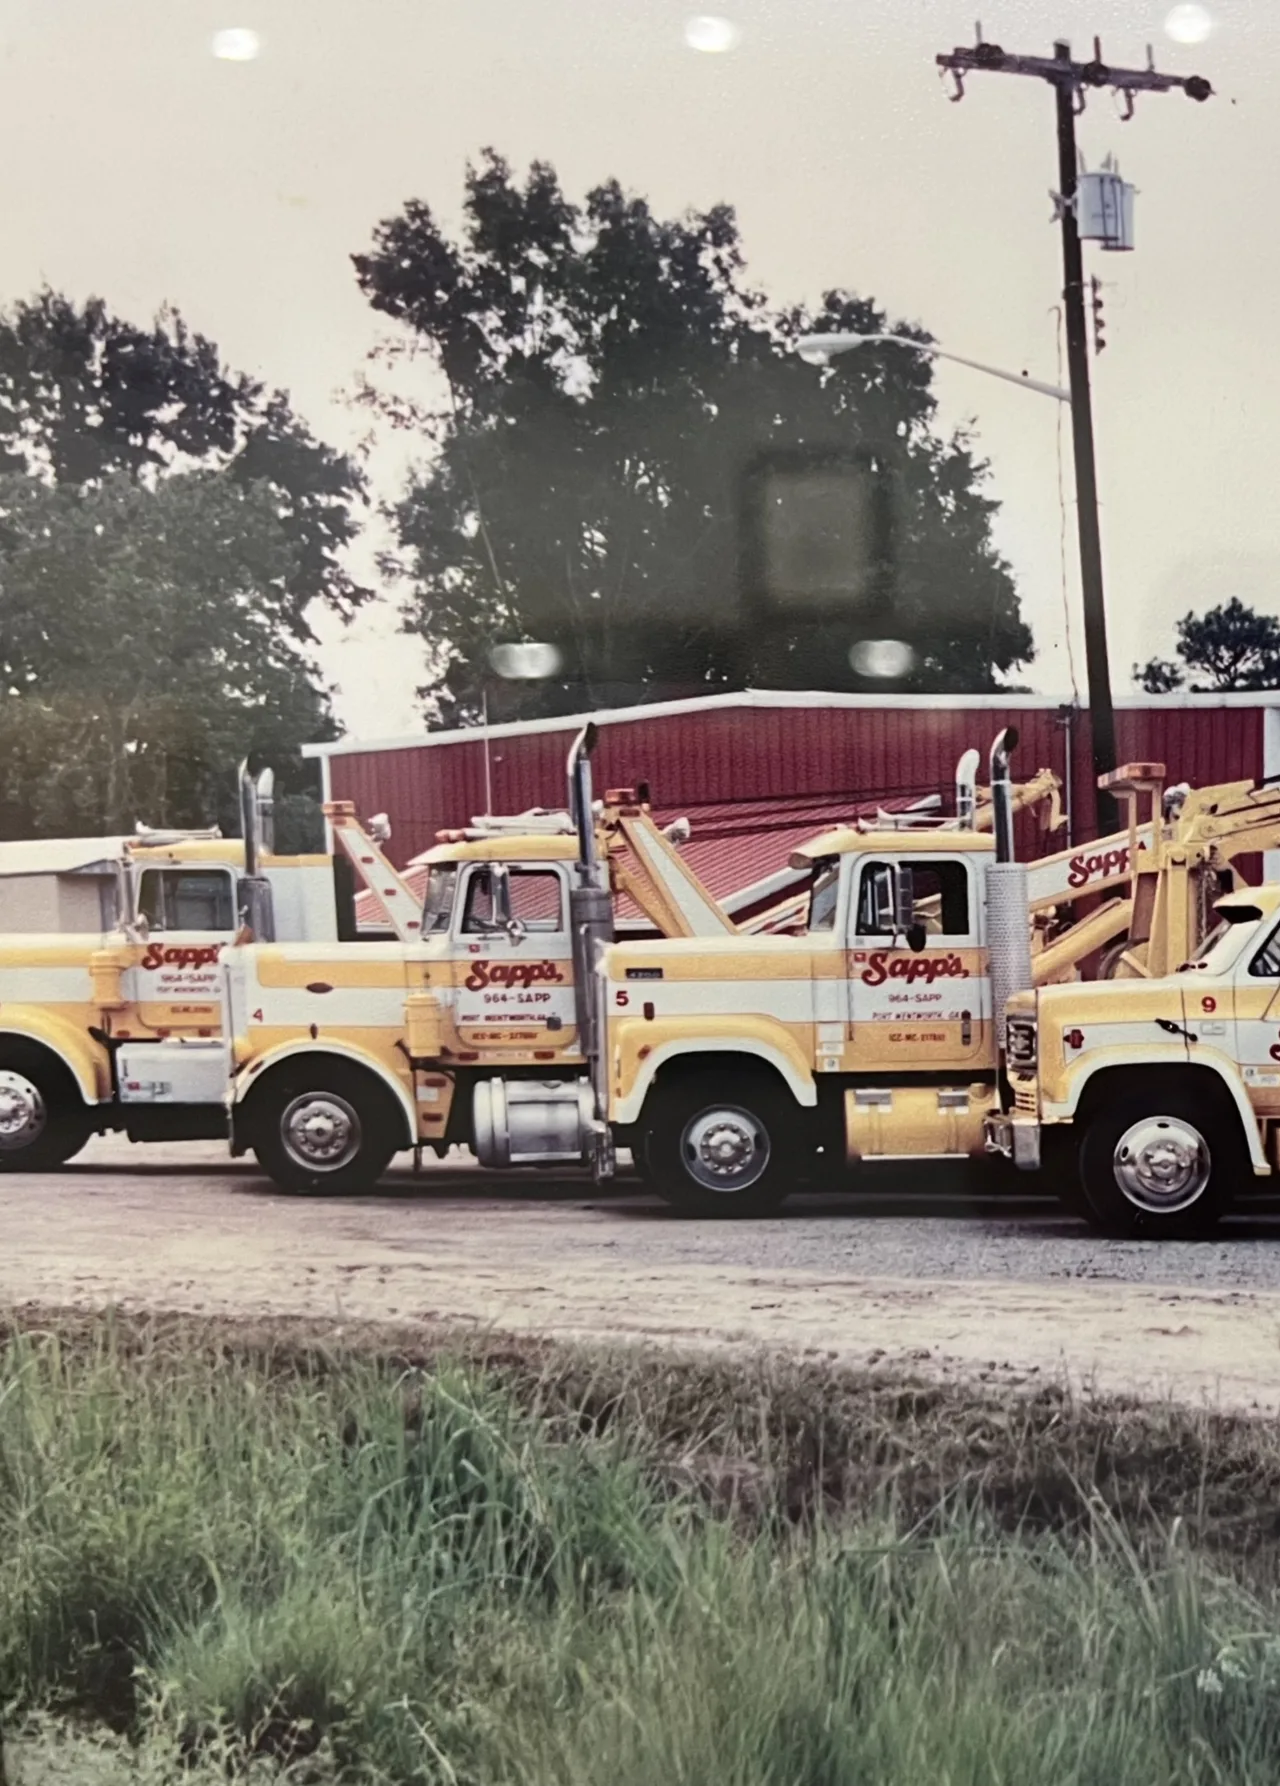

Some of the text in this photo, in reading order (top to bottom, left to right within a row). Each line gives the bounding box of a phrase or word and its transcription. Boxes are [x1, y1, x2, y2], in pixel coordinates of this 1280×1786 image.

[465, 960, 563, 991] Sapp's
[861, 952, 969, 986] Sapp's
[484, 993, 551, 1003] 964-SAPP
[616, 991, 629, 1007] 5
[1201, 996, 1217, 1013] 9
[253, 1008, 263, 1023] 4
